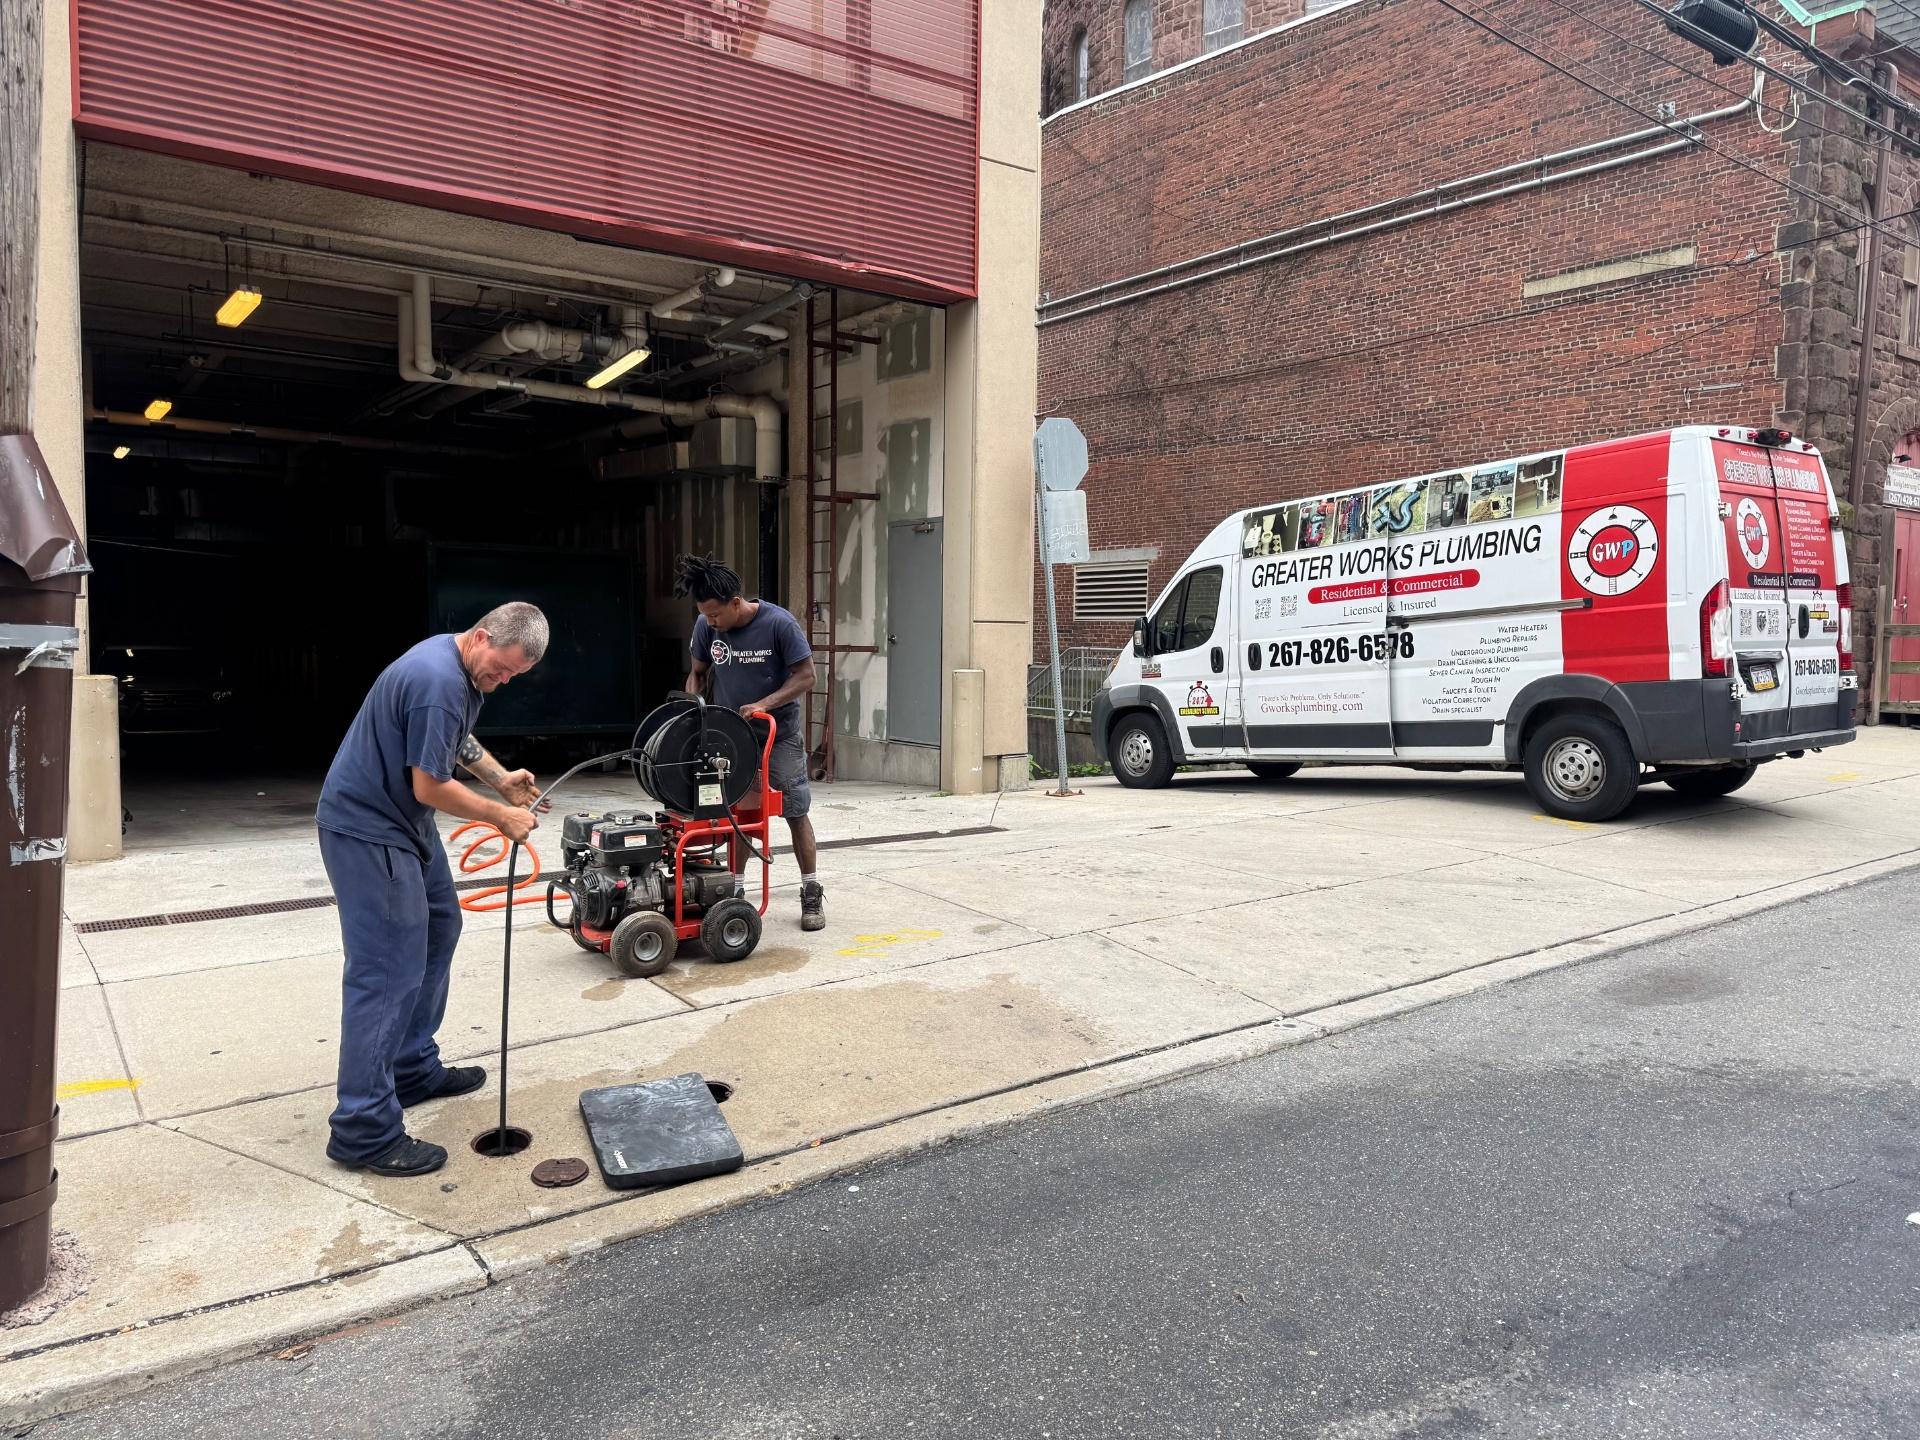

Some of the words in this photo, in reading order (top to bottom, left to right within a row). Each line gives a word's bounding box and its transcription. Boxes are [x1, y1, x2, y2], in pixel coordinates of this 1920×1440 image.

[1746, 526, 1761, 541] GWP
[1252, 554, 1333, 588] GREATER
[1340, 544, 1414, 576] WORKS
[1419, 524, 1542, 567] PLUMBING
[1592, 539, 1634, 563] GWP
[1754, 575, 1779, 586] Residential
[1781, 577, 1784, 586] &
[1789, 576, 1816, 587] Commercial
[1321, 585, 1376, 600] Residential
[1380, 581, 1390, 594] &
[1394, 574, 1464, 594] Commercial
[1734, 590, 1756, 600] Licensed
[1757, 592, 1762, 600] &
[1764, 591, 1781, 600] Insured
[1343, 602, 1383, 616] Licensed
[1387, 603, 1396, 612] &
[1400, 598, 1437, 611] Insured
[1498, 626, 1518, 634] WATER
[1520, 624, 1548, 632] HEATERS
[1480, 636, 1510, 644] PLUMBING
[1269, 632, 1414, 667] 267-826-6578
[1451, 648, 1495, 656] UNDERGROUND
[1497, 646, 1528, 654] PLUMBING
[1457, 658, 1486, 666] CLEANING
[1494, 656, 1520, 664] UNCLOG
[1429, 669, 1448, 677] SEWER
[1450, 668, 1473, 676] CAMERA
[1475, 666, 1510, 674] INSPECTION
[1795, 659, 1836, 676] 267-826-6578
[1471, 676, 1492, 684] ROUGH
[1796, 686, 1835, 696] Gworksplumbing.com
[1317, 693, 1331, 701] Only
[1422, 697, 1451, 705] VIOLATION
[1452, 696, 1491, 704] CORRECTION
[1260, 702, 1363, 714] Gworksplumbing.com
[1432, 706, 1450, 714] DRAIN
